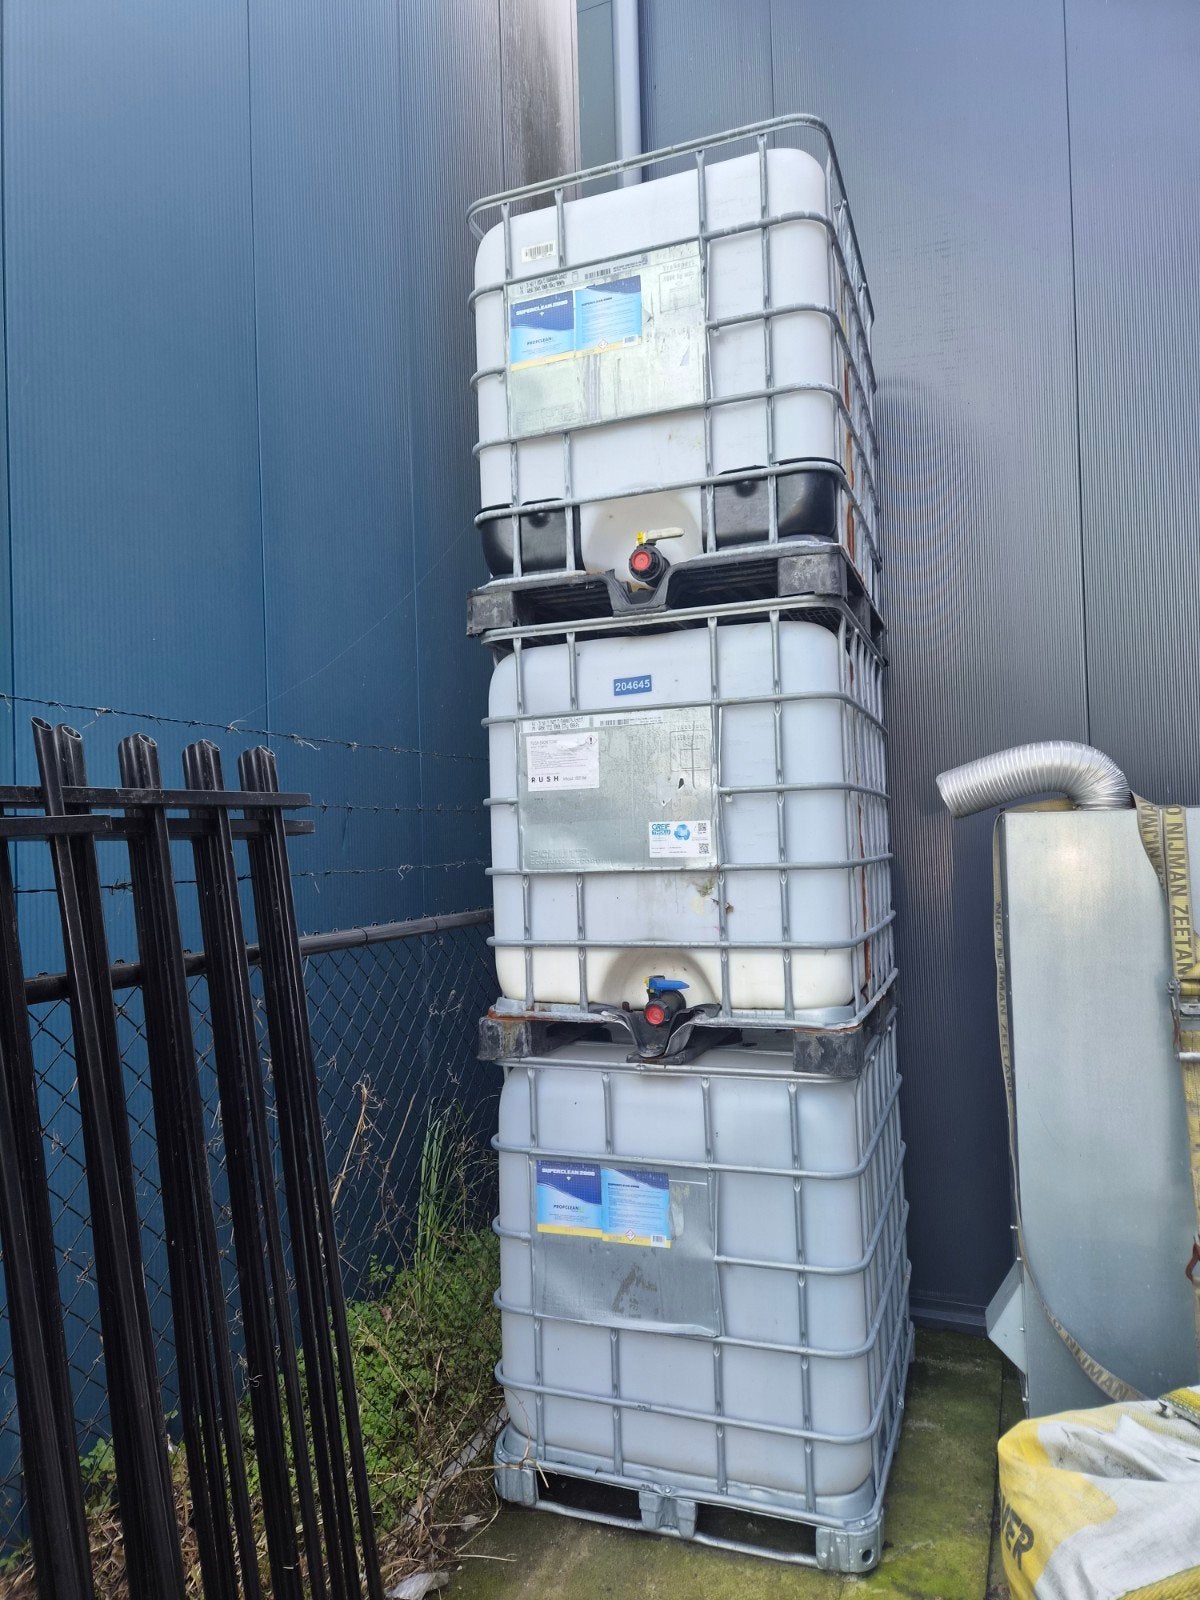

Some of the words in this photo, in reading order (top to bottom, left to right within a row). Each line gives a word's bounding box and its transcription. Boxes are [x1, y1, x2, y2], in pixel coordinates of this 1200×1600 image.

[615, 679, 650, 692] 204645
[531, 775, 559, 783] RUSH
[1166, 822, 1188, 897] NIJMAN
